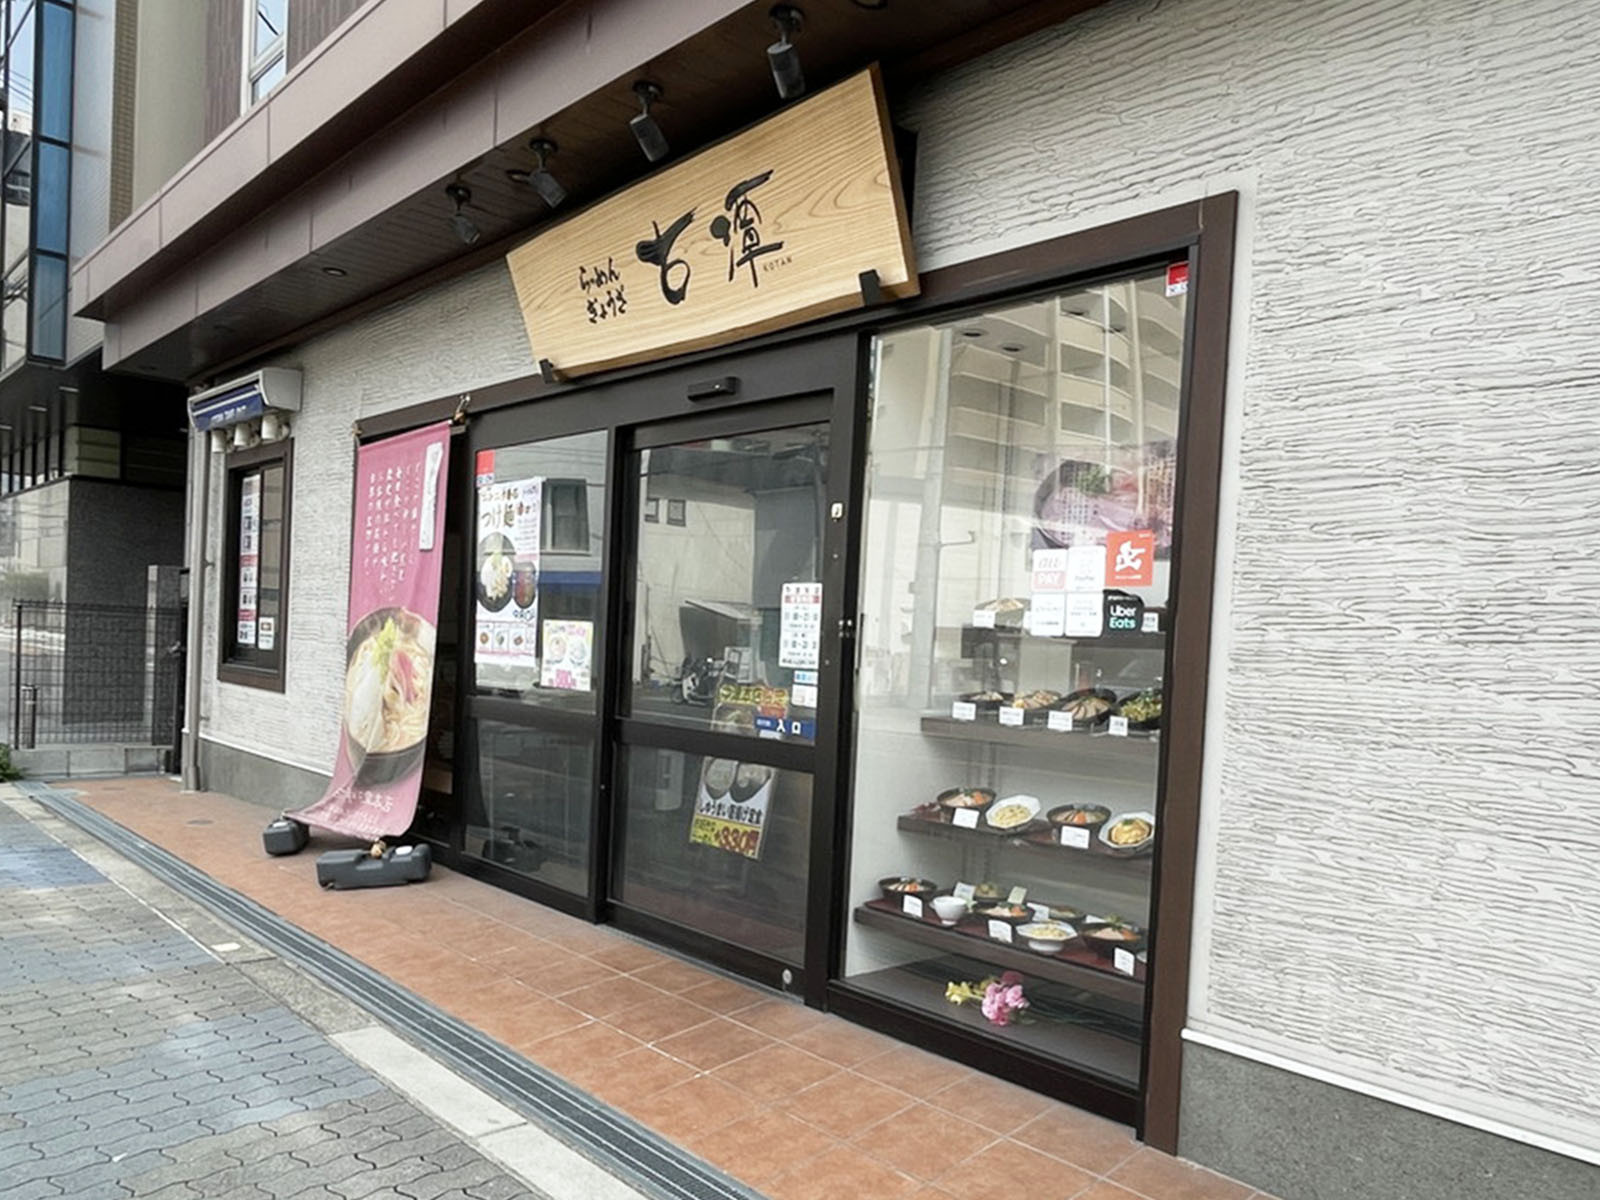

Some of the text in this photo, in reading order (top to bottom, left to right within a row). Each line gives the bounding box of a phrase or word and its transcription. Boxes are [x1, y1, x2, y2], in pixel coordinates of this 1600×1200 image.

[762, 256, 793, 273] KOTAN
[587, 284, 627, 324] ぎょうざ
[1110, 604, 1137, 617] Uber
[1109, 617, 1136, 629] Eats
